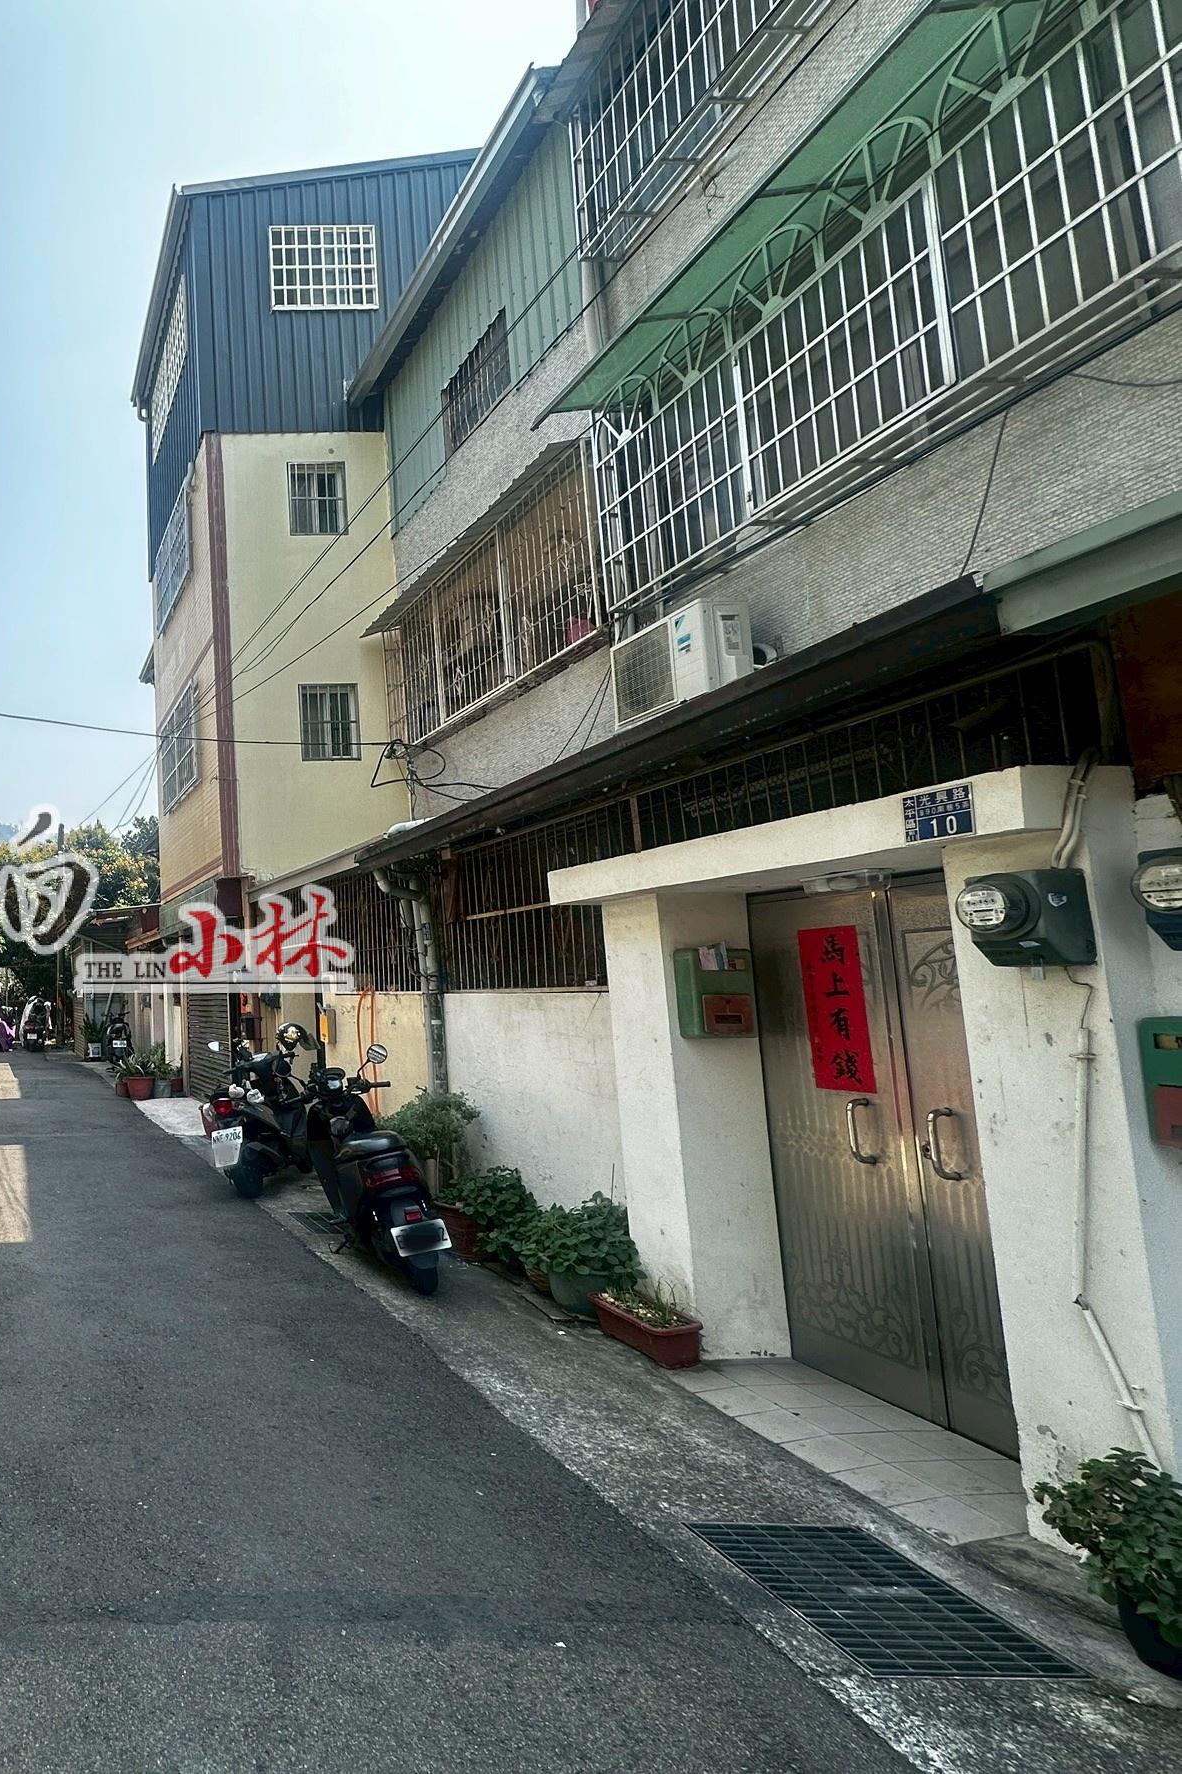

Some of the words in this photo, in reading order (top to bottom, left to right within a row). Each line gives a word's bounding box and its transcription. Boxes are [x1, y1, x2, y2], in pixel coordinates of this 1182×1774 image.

[919, 787, 966, 807] 光興路
[904, 798, 917, 830] 太平區
[929, 815, 958, 837] 10
[820, 932, 863, 1086] 馬上有錢
